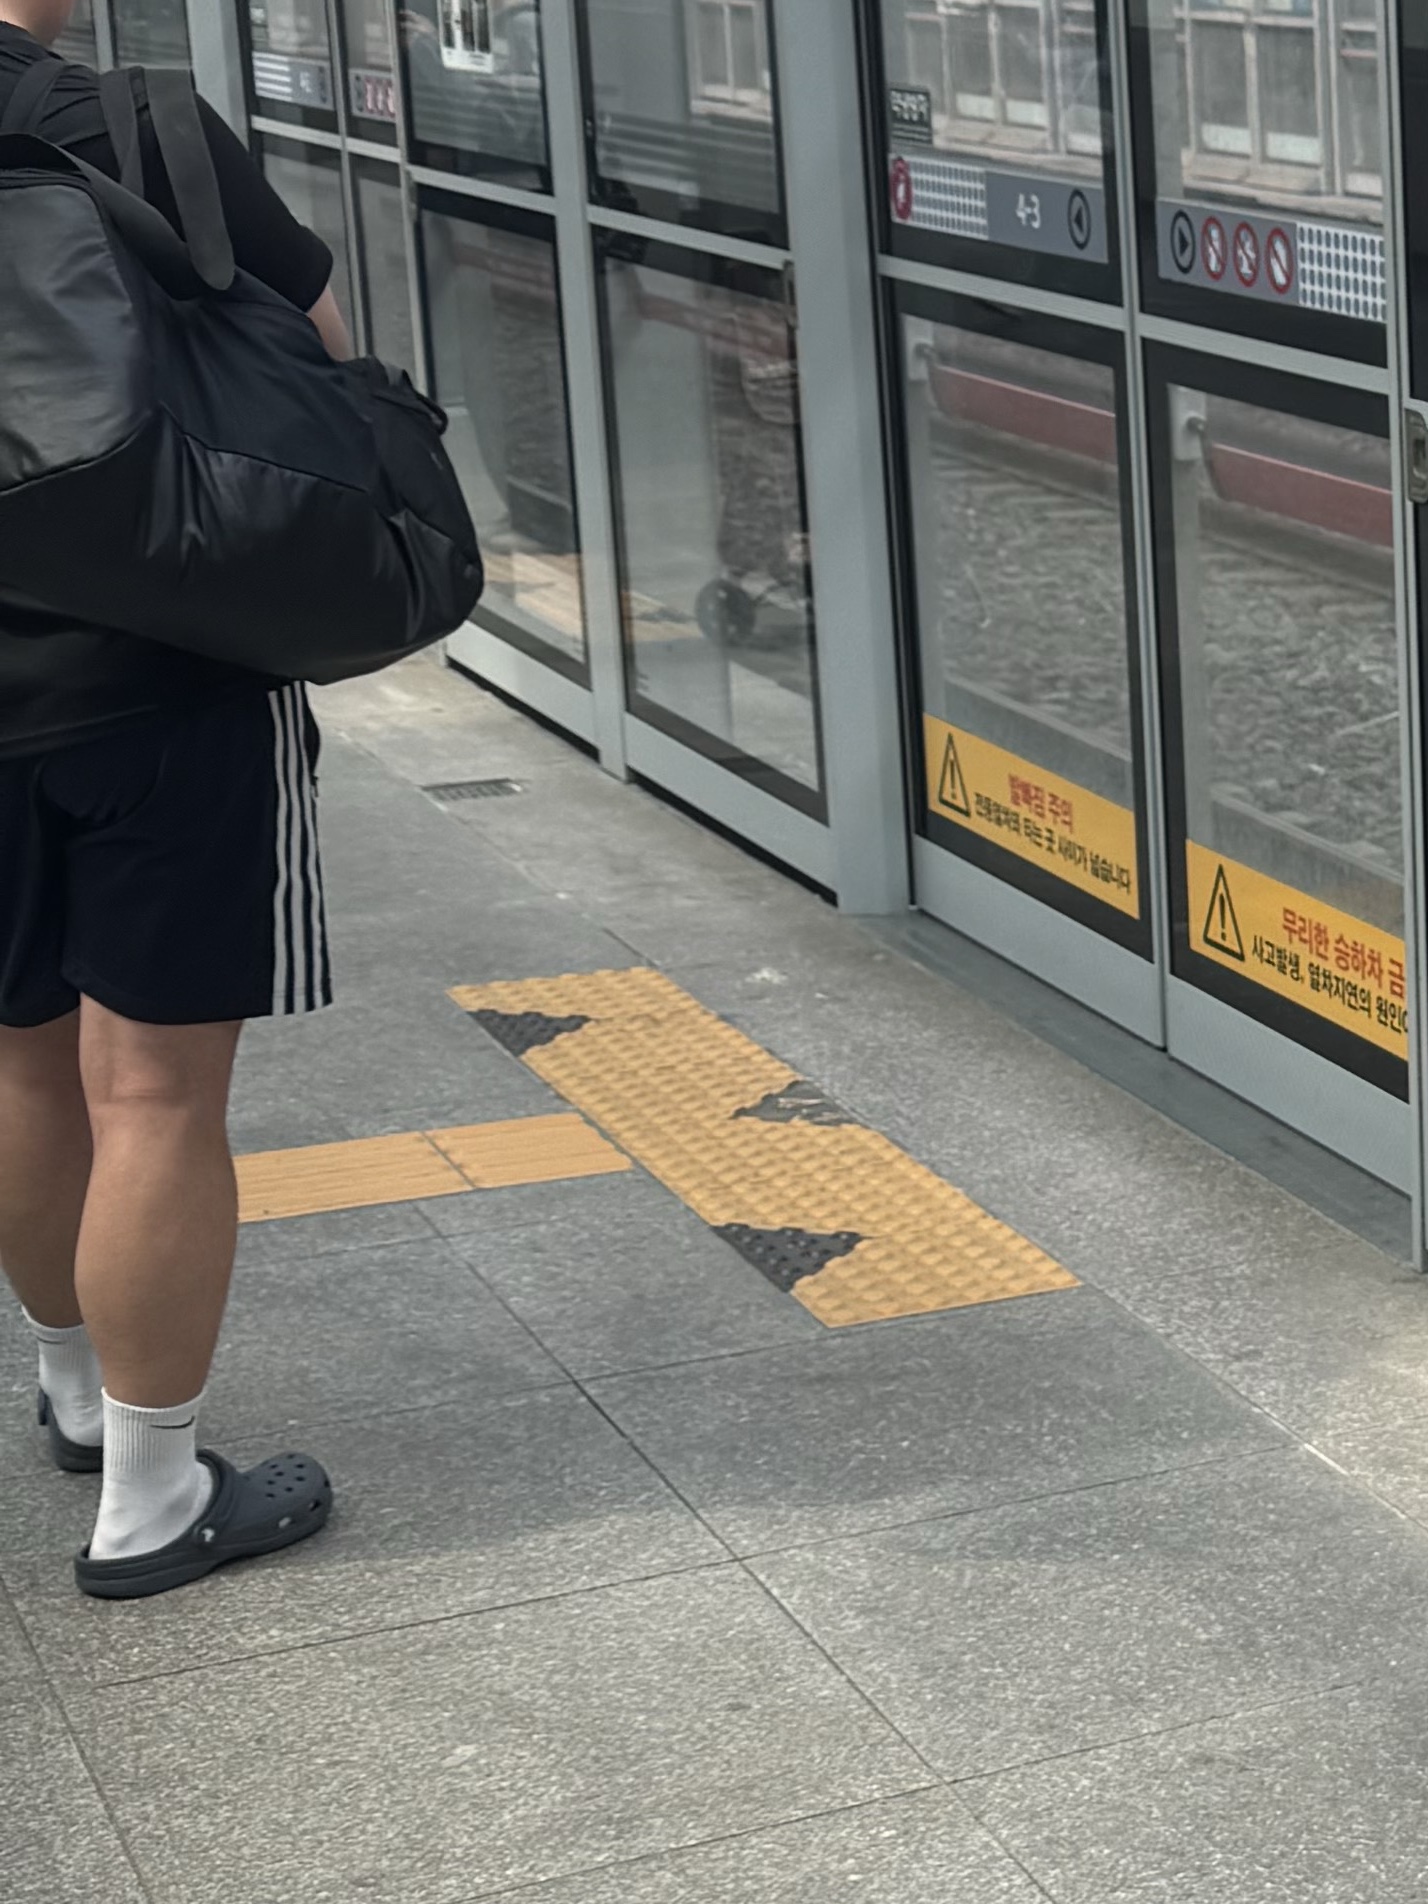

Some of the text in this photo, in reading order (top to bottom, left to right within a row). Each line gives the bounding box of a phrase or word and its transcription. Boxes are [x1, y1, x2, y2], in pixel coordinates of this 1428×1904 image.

[1016, 193, 1041, 229] 4-3
[1048, 792, 1074, 834] 주의
[1252, 934, 1305, 984] 사고발생,
[1308, 962, 1372, 1019] 열차지연의
[1282, 907, 1330, 962] 무리한
[1334, 933, 1384, 989] 승하차
